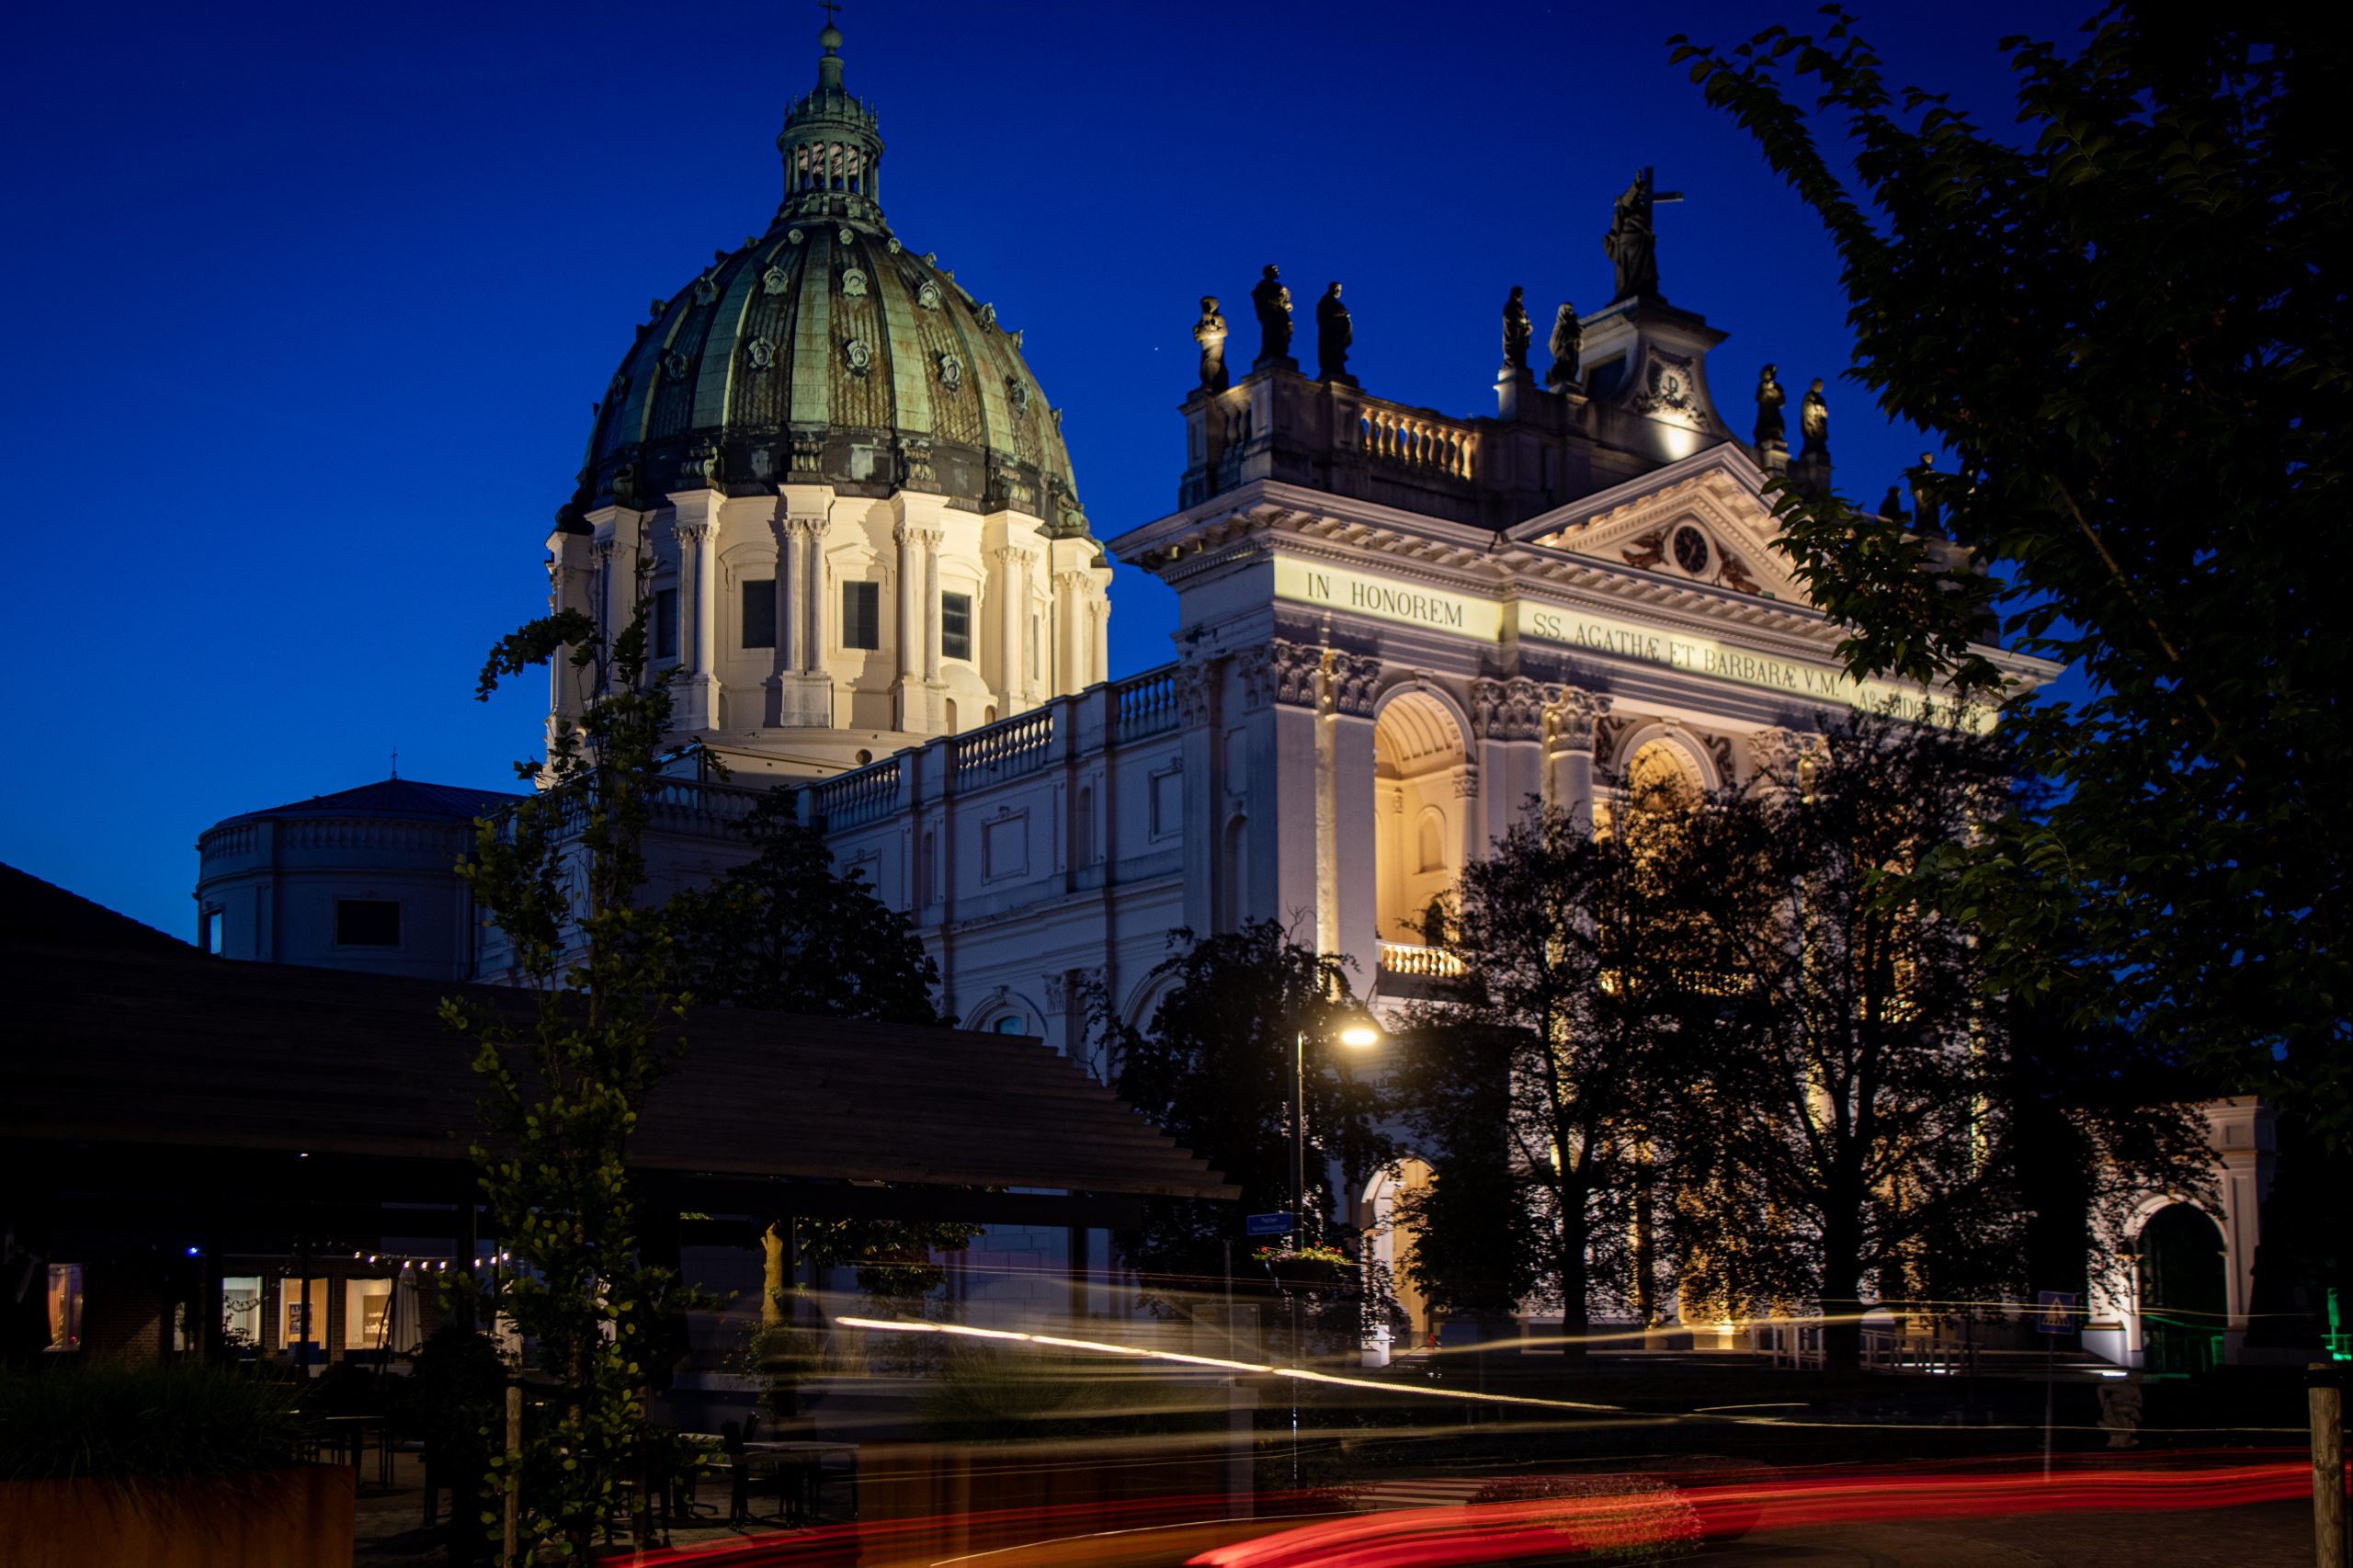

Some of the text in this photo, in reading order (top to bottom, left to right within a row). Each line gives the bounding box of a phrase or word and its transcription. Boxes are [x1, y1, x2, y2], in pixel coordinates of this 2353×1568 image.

[1307, 573, 1463, 628] IN HONOREM
[1532, 612, 1565, 641] SS.
[1669, 641, 1696, 667] ET
